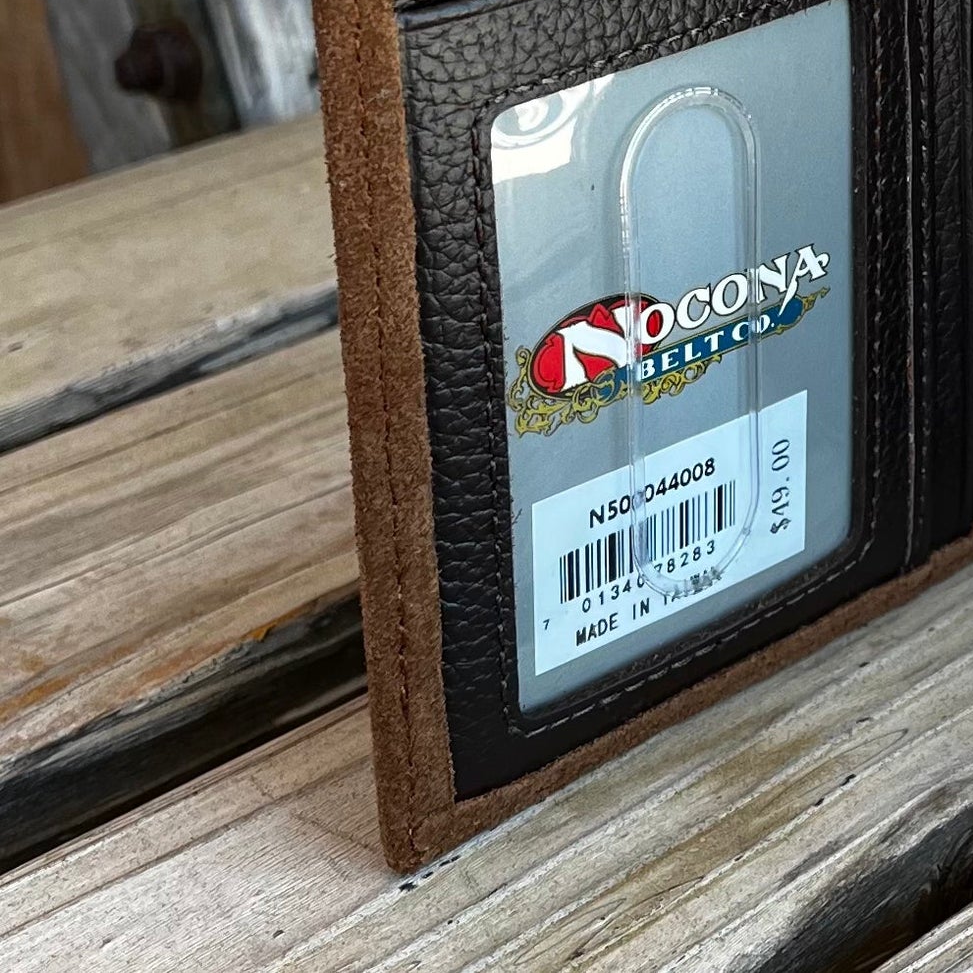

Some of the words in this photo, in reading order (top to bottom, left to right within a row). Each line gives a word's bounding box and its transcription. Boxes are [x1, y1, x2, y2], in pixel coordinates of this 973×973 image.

[556, 243, 831, 392] NOCONA
[641, 330, 726, 381] BELT
[731, 314, 776, 342] CO.
[542, 618, 551, 630] 7
[575, 612, 619, 647] MADE
[632, 597, 650, 621] IN
